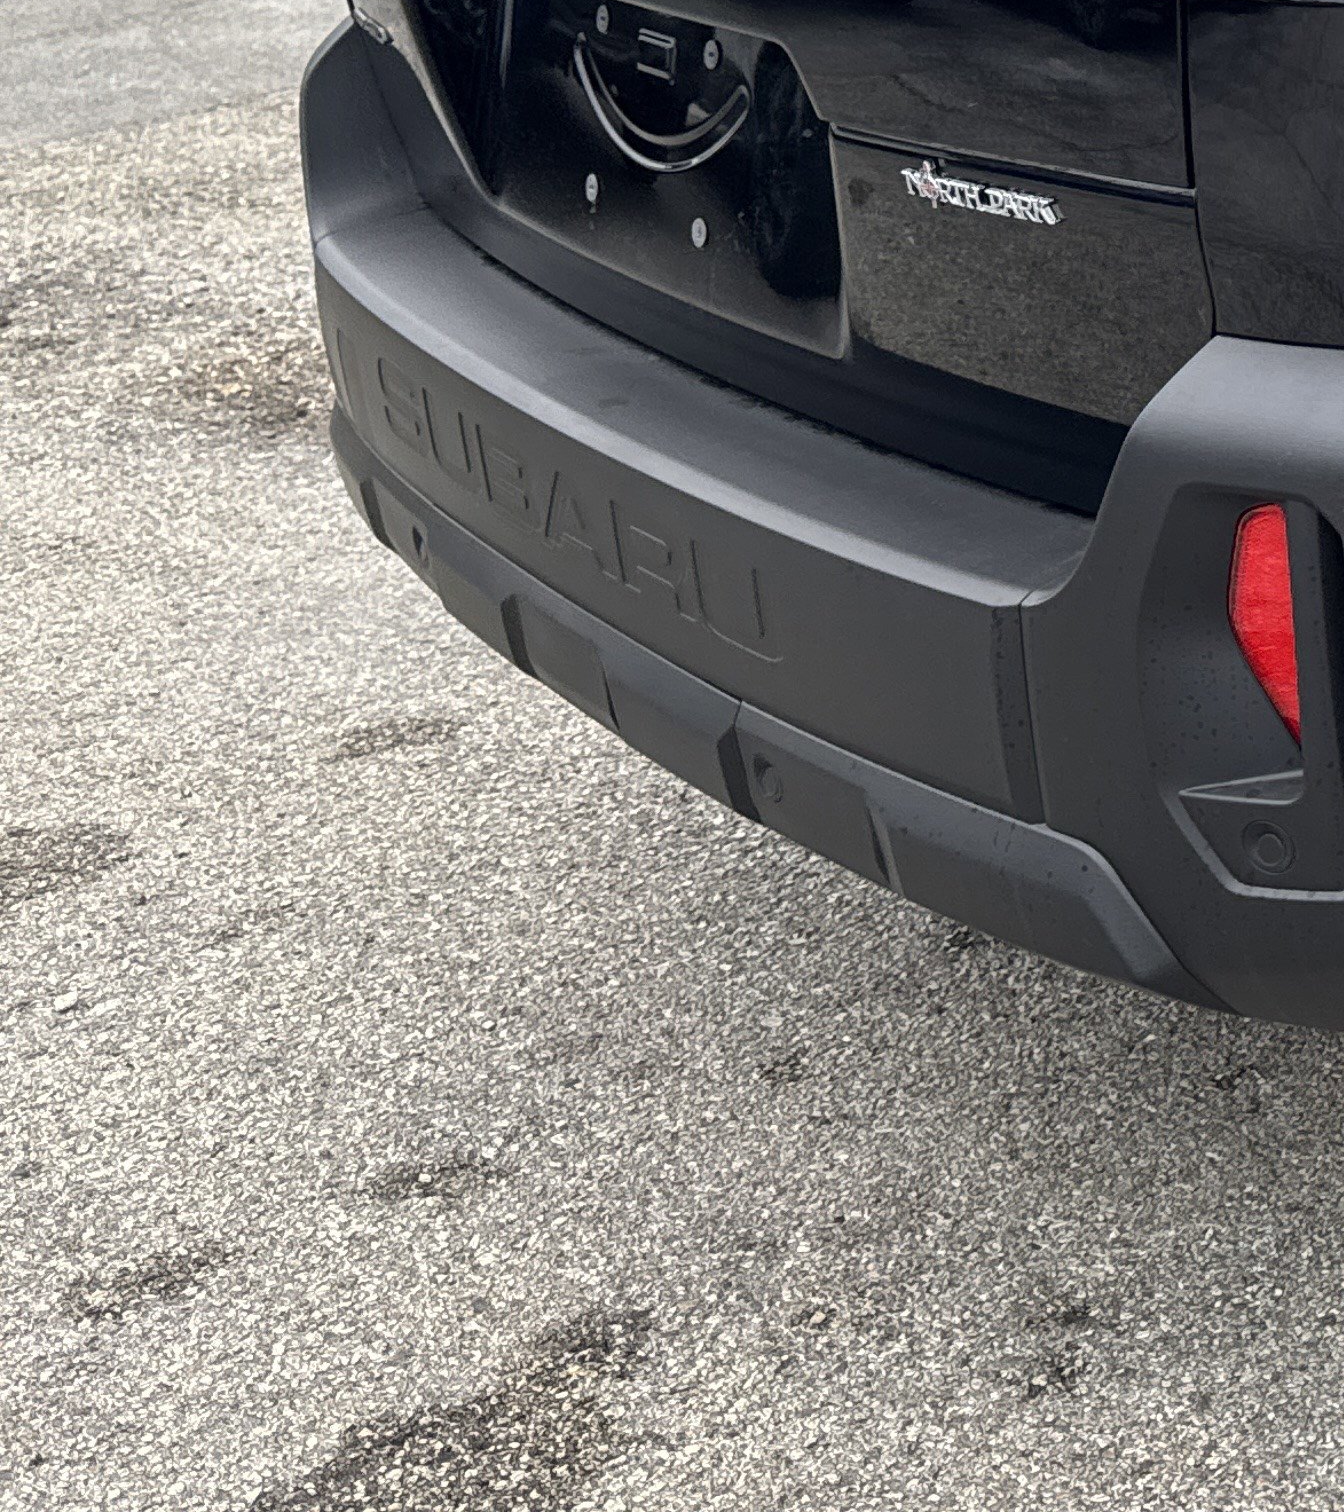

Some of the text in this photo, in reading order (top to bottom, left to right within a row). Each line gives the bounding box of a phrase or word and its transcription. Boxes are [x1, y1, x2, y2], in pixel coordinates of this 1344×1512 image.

[901, 165, 1056, 226] NORTH PARK
[378, 356, 784, 663] SUBARU
